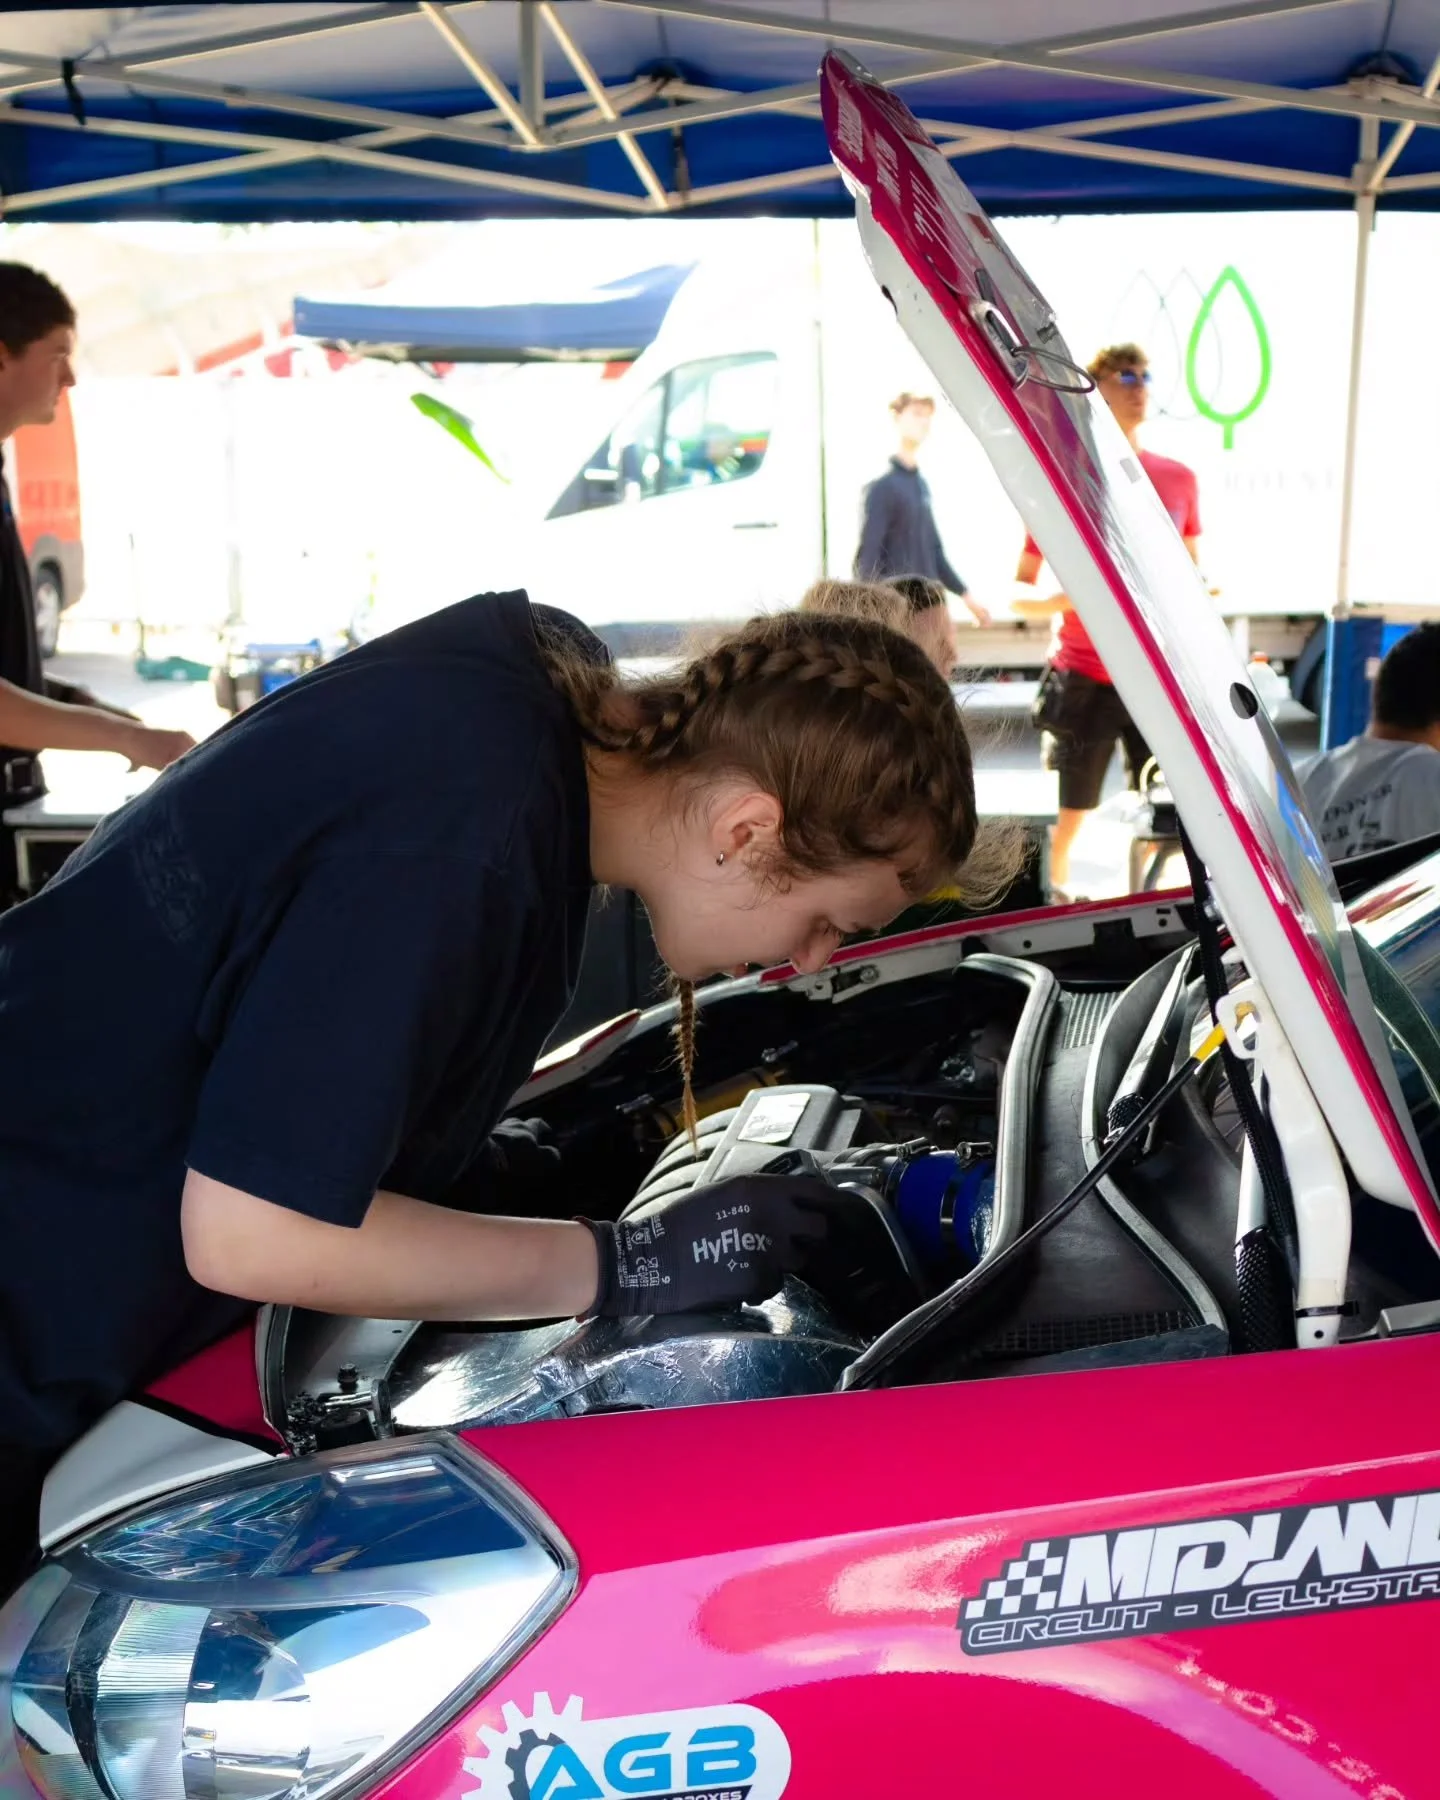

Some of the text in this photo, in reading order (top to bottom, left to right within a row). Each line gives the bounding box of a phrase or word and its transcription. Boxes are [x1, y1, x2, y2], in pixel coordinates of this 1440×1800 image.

[715, 1204, 750, 1221] 11-840
[692, 1227, 767, 1263] HyFlex
[968, 1602, 1161, 1648] CIRCUIT
[528, 1724, 757, 1800] AGB
